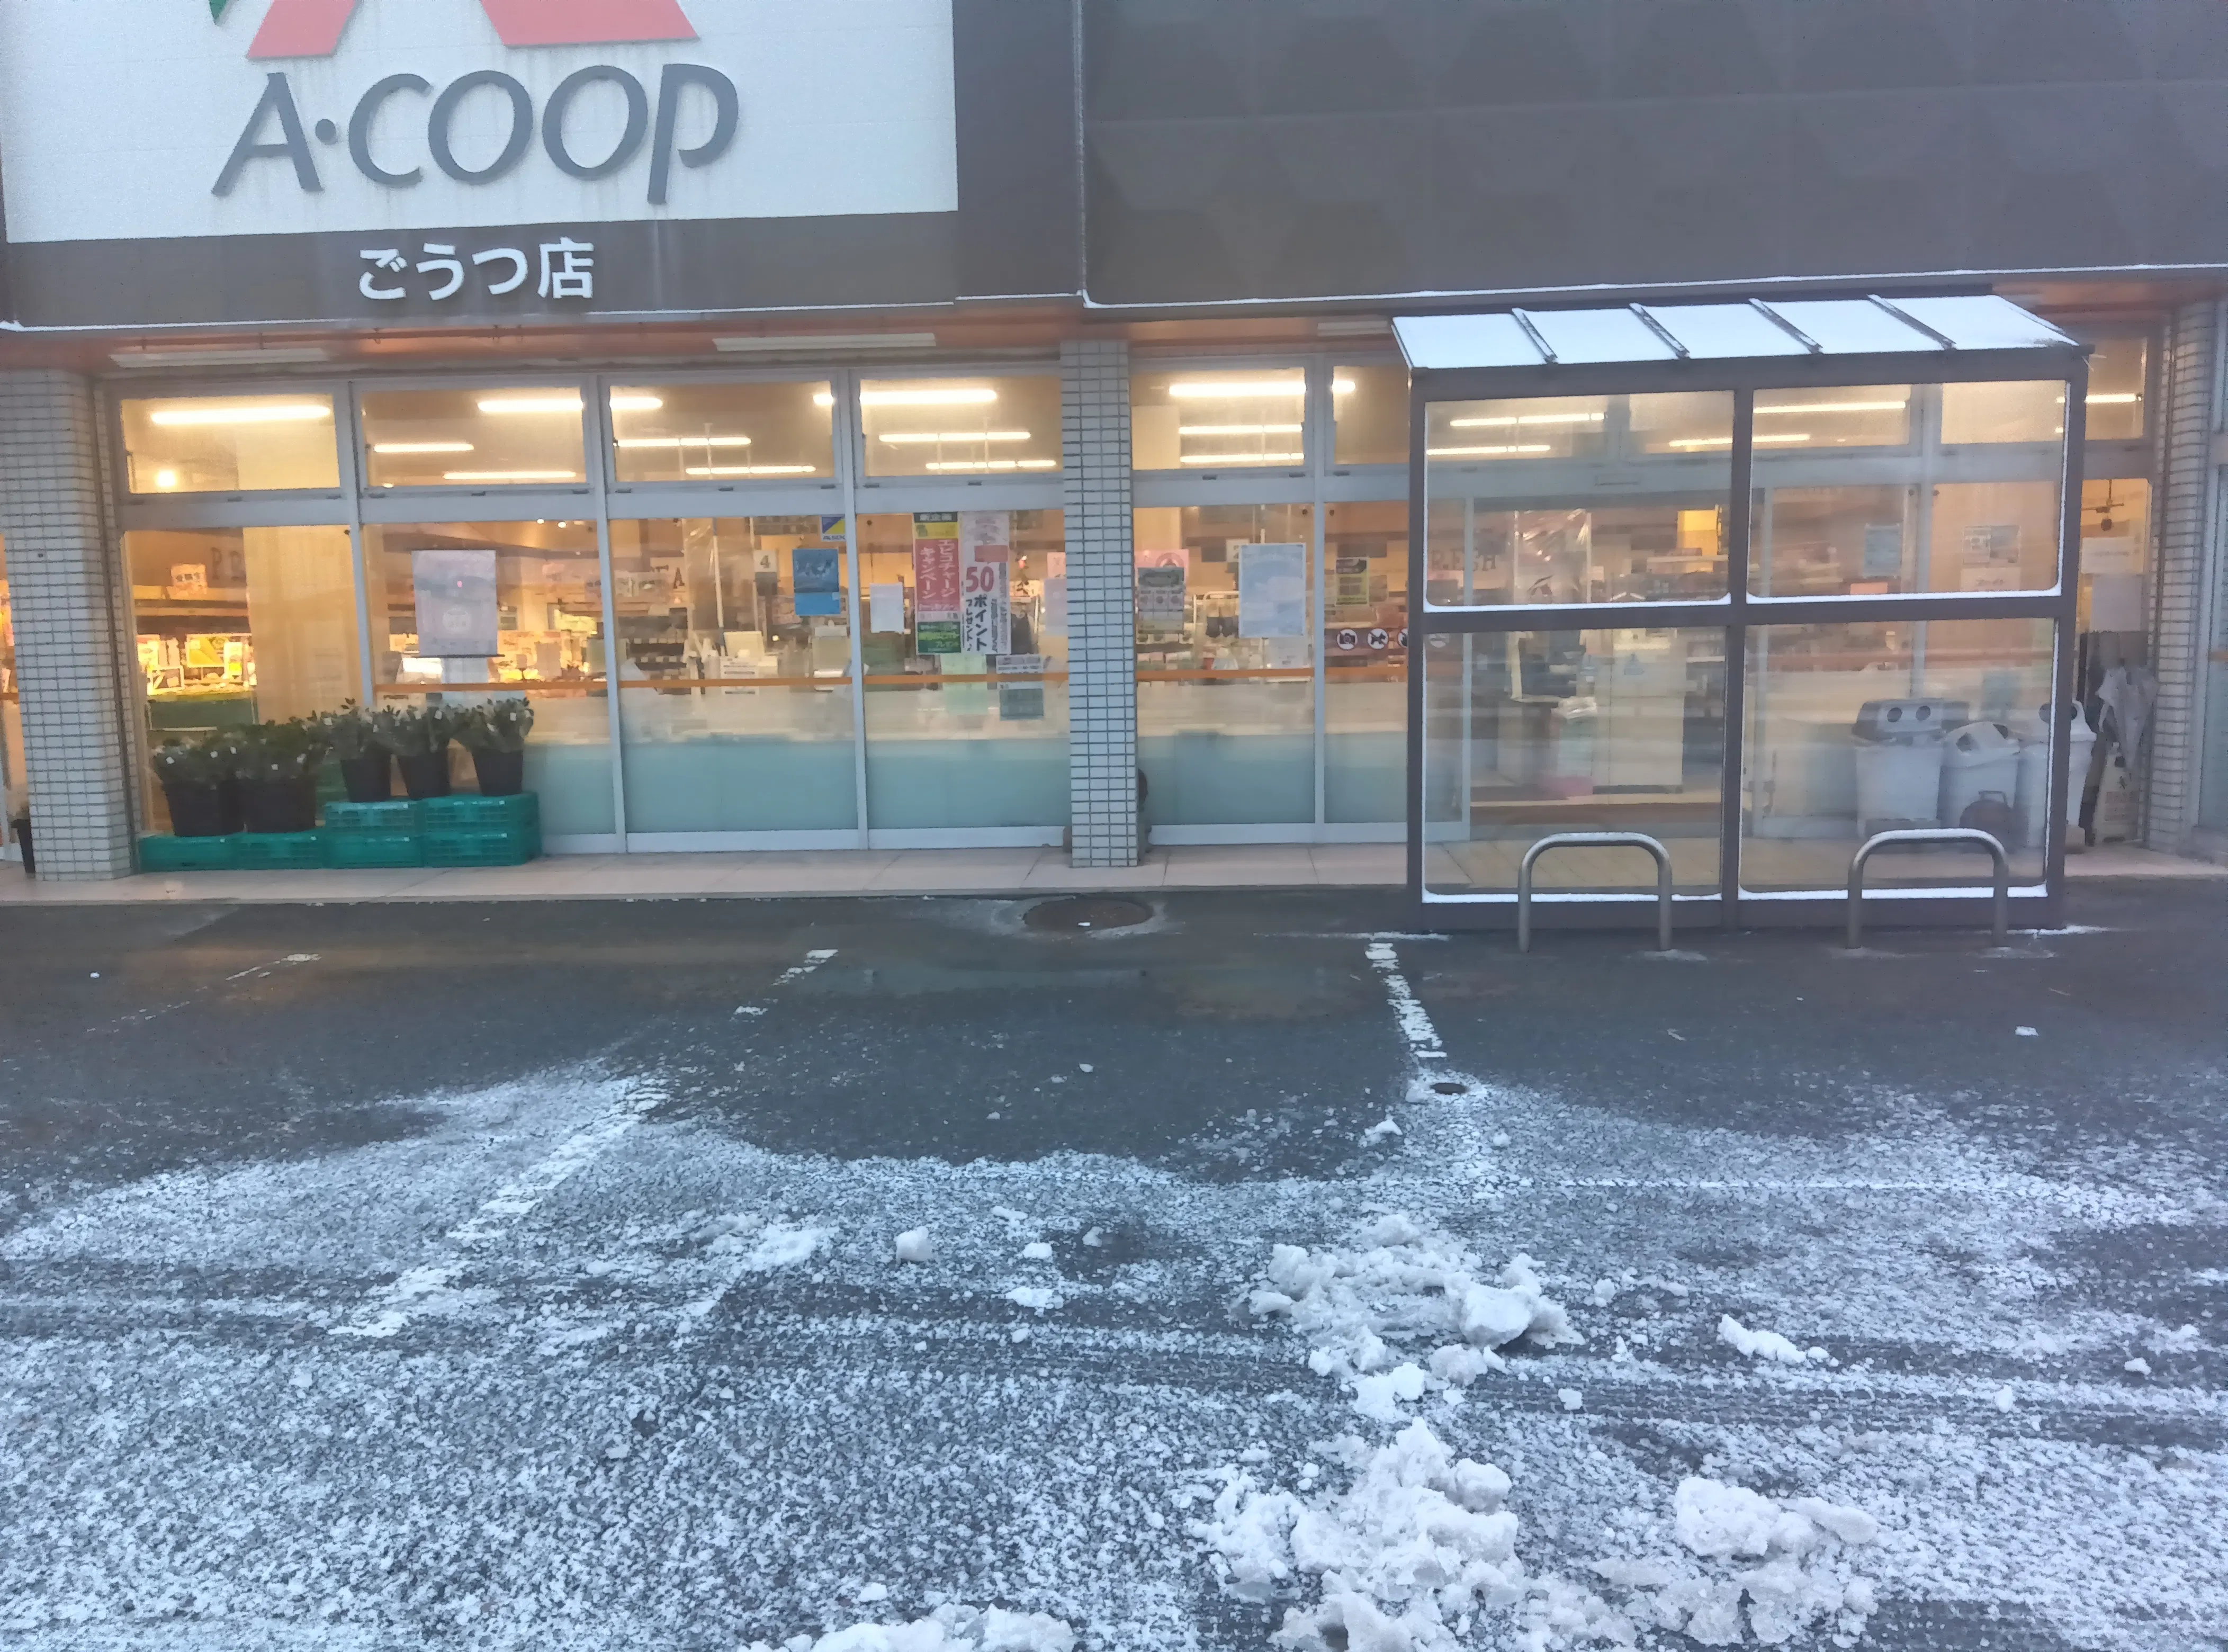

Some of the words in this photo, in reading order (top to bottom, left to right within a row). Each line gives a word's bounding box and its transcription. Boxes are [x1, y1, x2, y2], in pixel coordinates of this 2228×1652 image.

[358, 237, 595, 301] ごうつ店
[919, 546, 937, 599] キャンペーン
[966, 566, 994, 592] 50
[974, 594, 988, 651] ポイント
